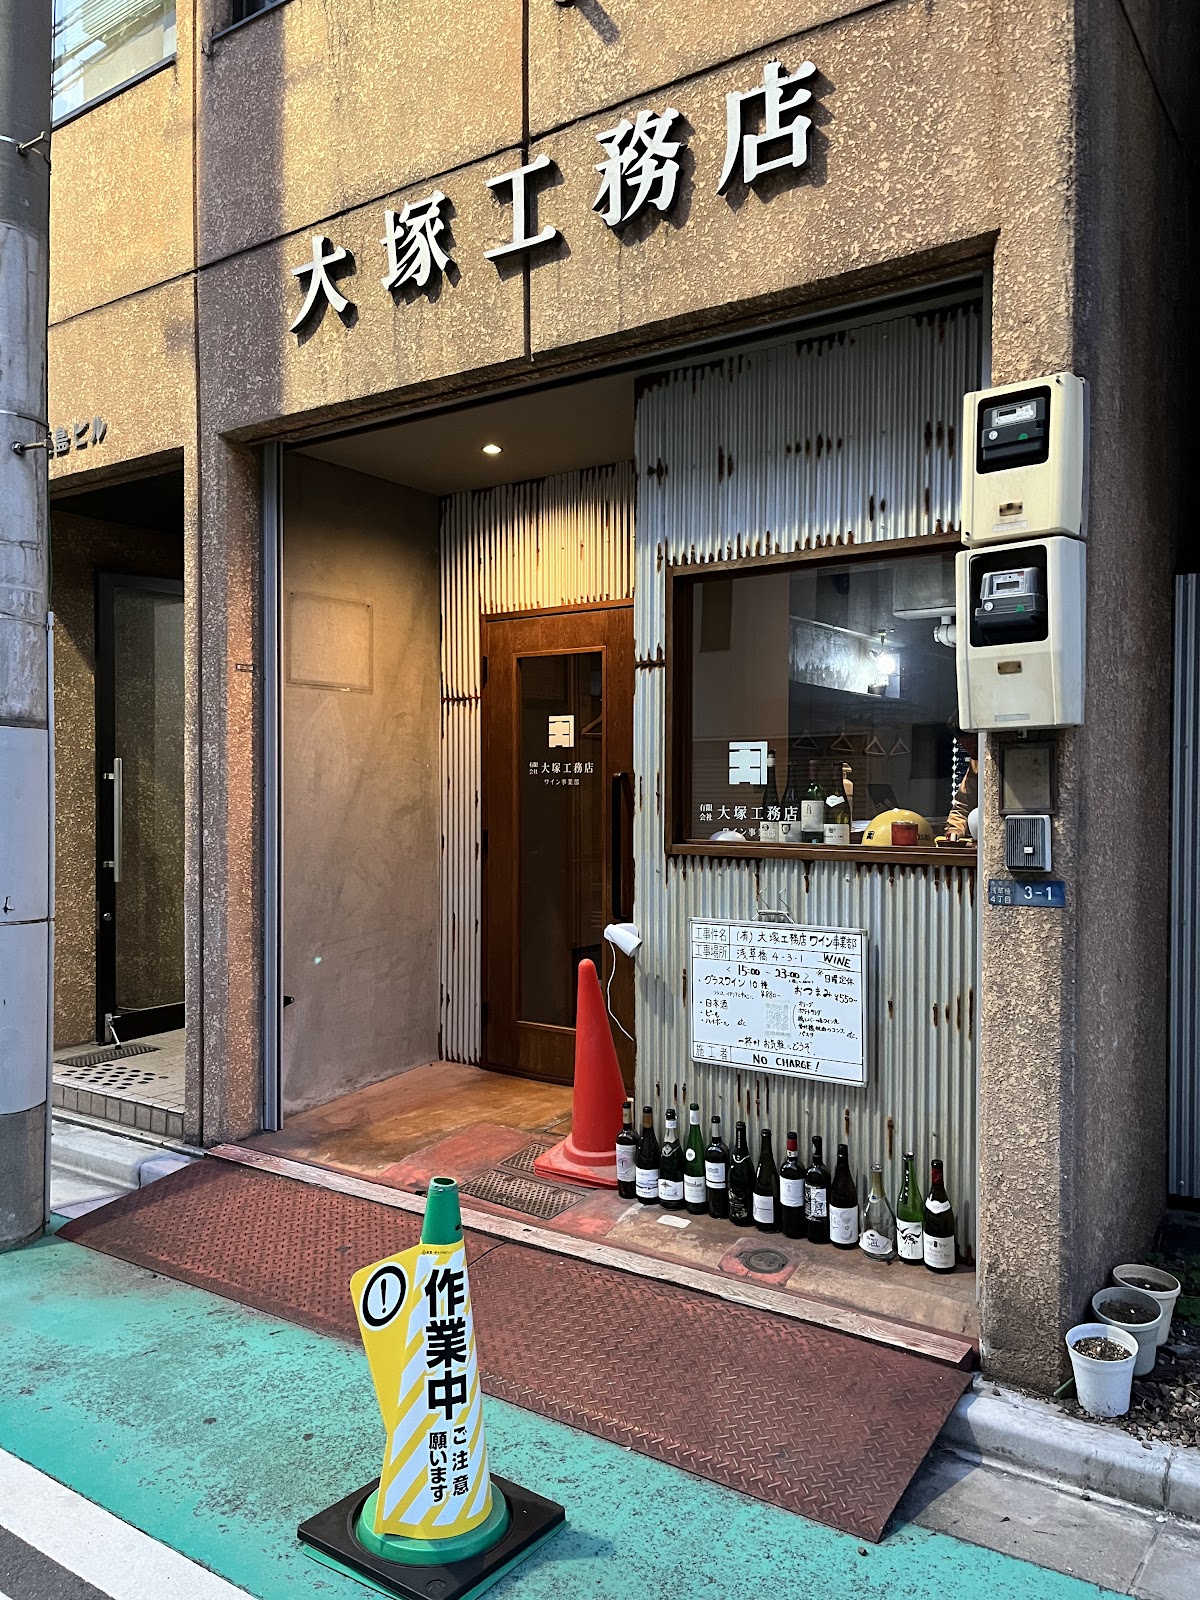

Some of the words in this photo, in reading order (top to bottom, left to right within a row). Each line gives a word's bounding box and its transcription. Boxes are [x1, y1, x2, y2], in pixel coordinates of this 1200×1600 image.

[288, 60, 817, 334] 大塚工務店
[49, 416, 108, 456] 島ビル
[540, 761, 594, 774] 大塚工務店
[544, 778, 580, 786] ワイン事業部
[699, 813, 713, 821] 会社
[717, 804, 799, 821] 大塚工務店
[990, 895, 1011, 904] 4丁目
[1023, 885, 1052, 901] 3-1
[695, 927, 727, 942] 工事件名
[695, 944, 727, 960] 工事場所
[823, 953, 851, 969] WINE
[794, 985, 833, 998] おつまみ
[705, 999, 728, 1010] 日本酒
[705, 1009, 720, 1019] ビール
[696, 1044, 728, 1060] 施工者
[752, 1053, 768, 1065] NO
[424, 1267, 468, 1421] 作業中
[428, 1431, 448, 1503] 願います
[452, 1425, 470, 1497] ご注意
